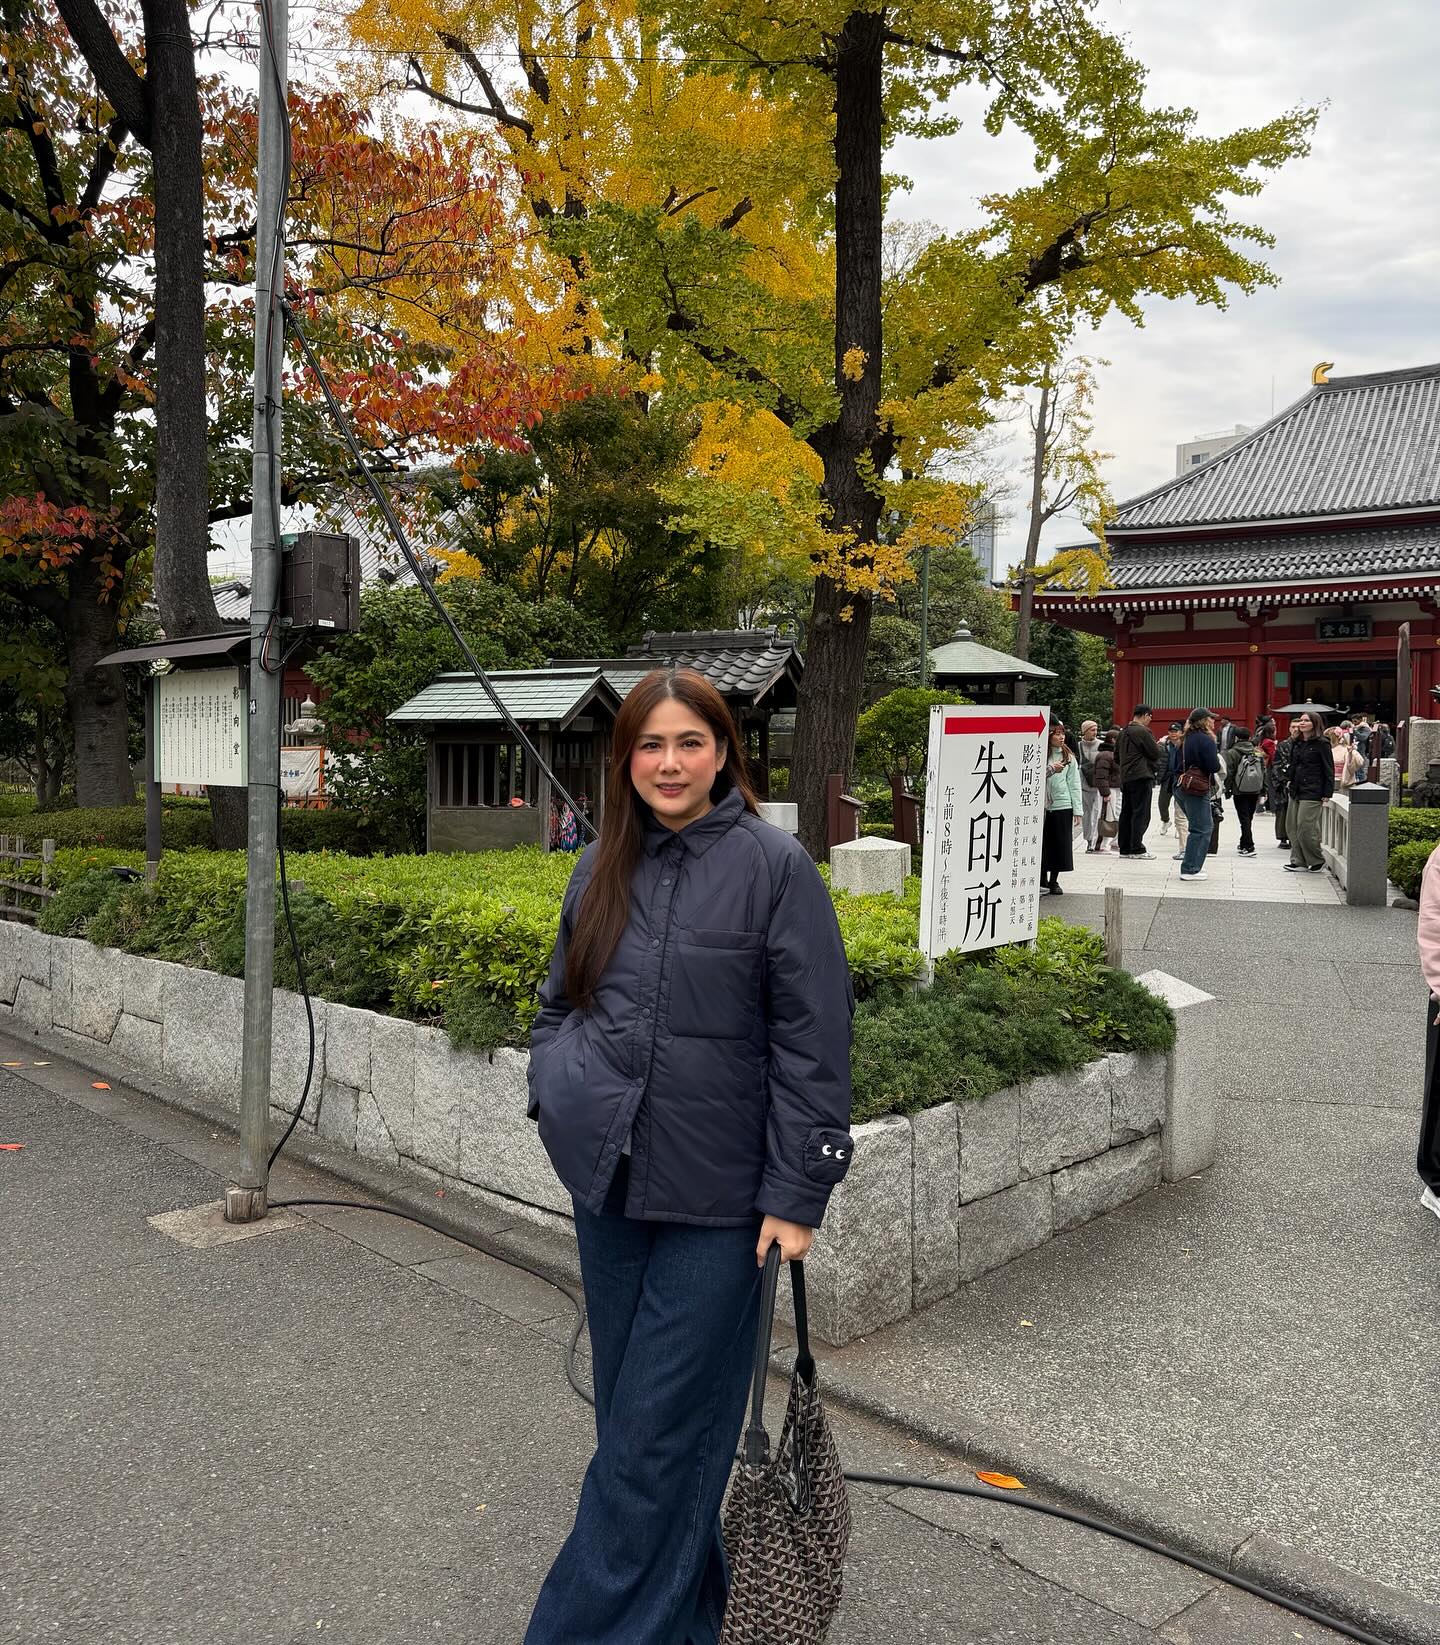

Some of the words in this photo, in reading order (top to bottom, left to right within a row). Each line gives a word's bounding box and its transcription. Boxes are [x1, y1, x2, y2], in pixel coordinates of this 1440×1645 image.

[1019, 743, 1034, 807] 影向堂
[1033, 744, 1042, 807] ようごうどう
[961, 740, 1008, 944] 朱印所
